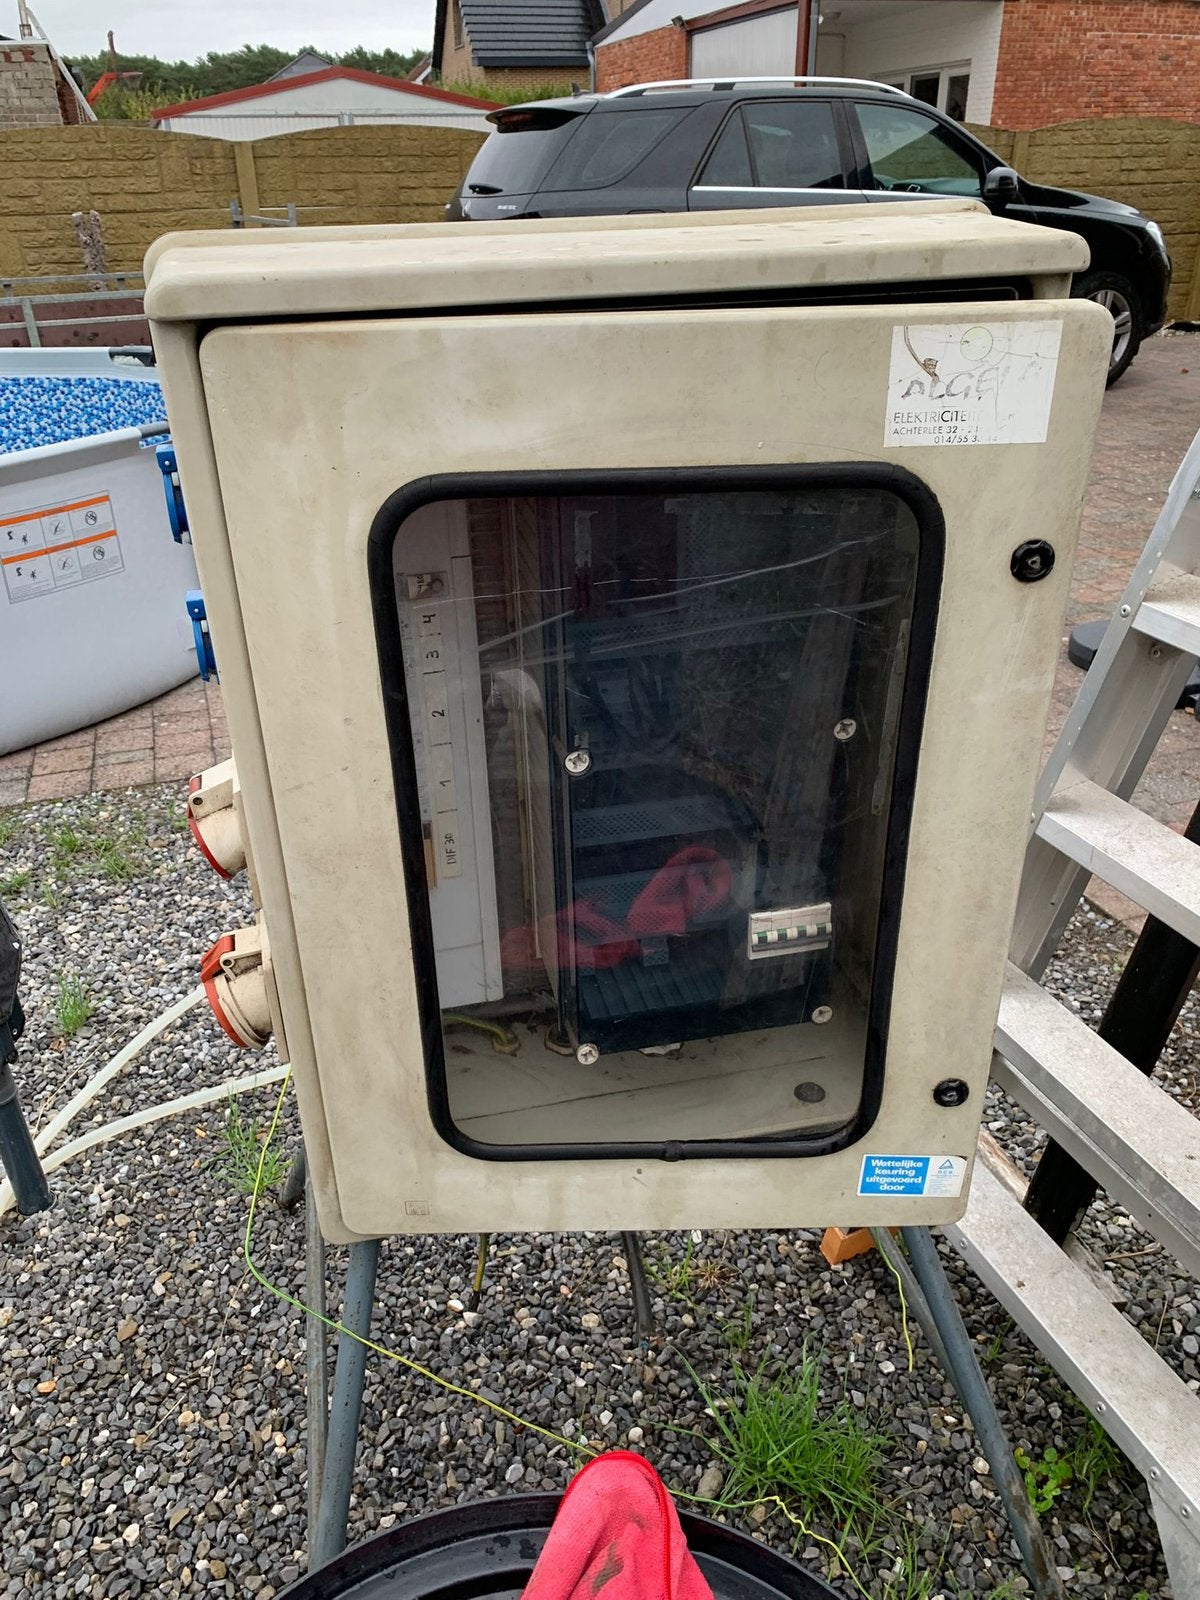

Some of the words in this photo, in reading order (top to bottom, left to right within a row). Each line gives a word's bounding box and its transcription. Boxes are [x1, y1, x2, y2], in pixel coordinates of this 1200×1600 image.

[893, 426, 943, 436] ACHTERLEE
[946, 425, 958, 434] 32
[934, 434, 969, 444] 014/55
[423, 613, 436, 623] 4
[426, 650, 439, 659] 3
[432, 709, 445, 718] 2
[439, 779, 451, 788] 1
[871, 1159, 923, 1169] Wettelijke
[875, 1167, 915, 1176] keuring
[866, 1176, 922, 1185] uitgevoerd
[880, 1183, 905, 1191] door
